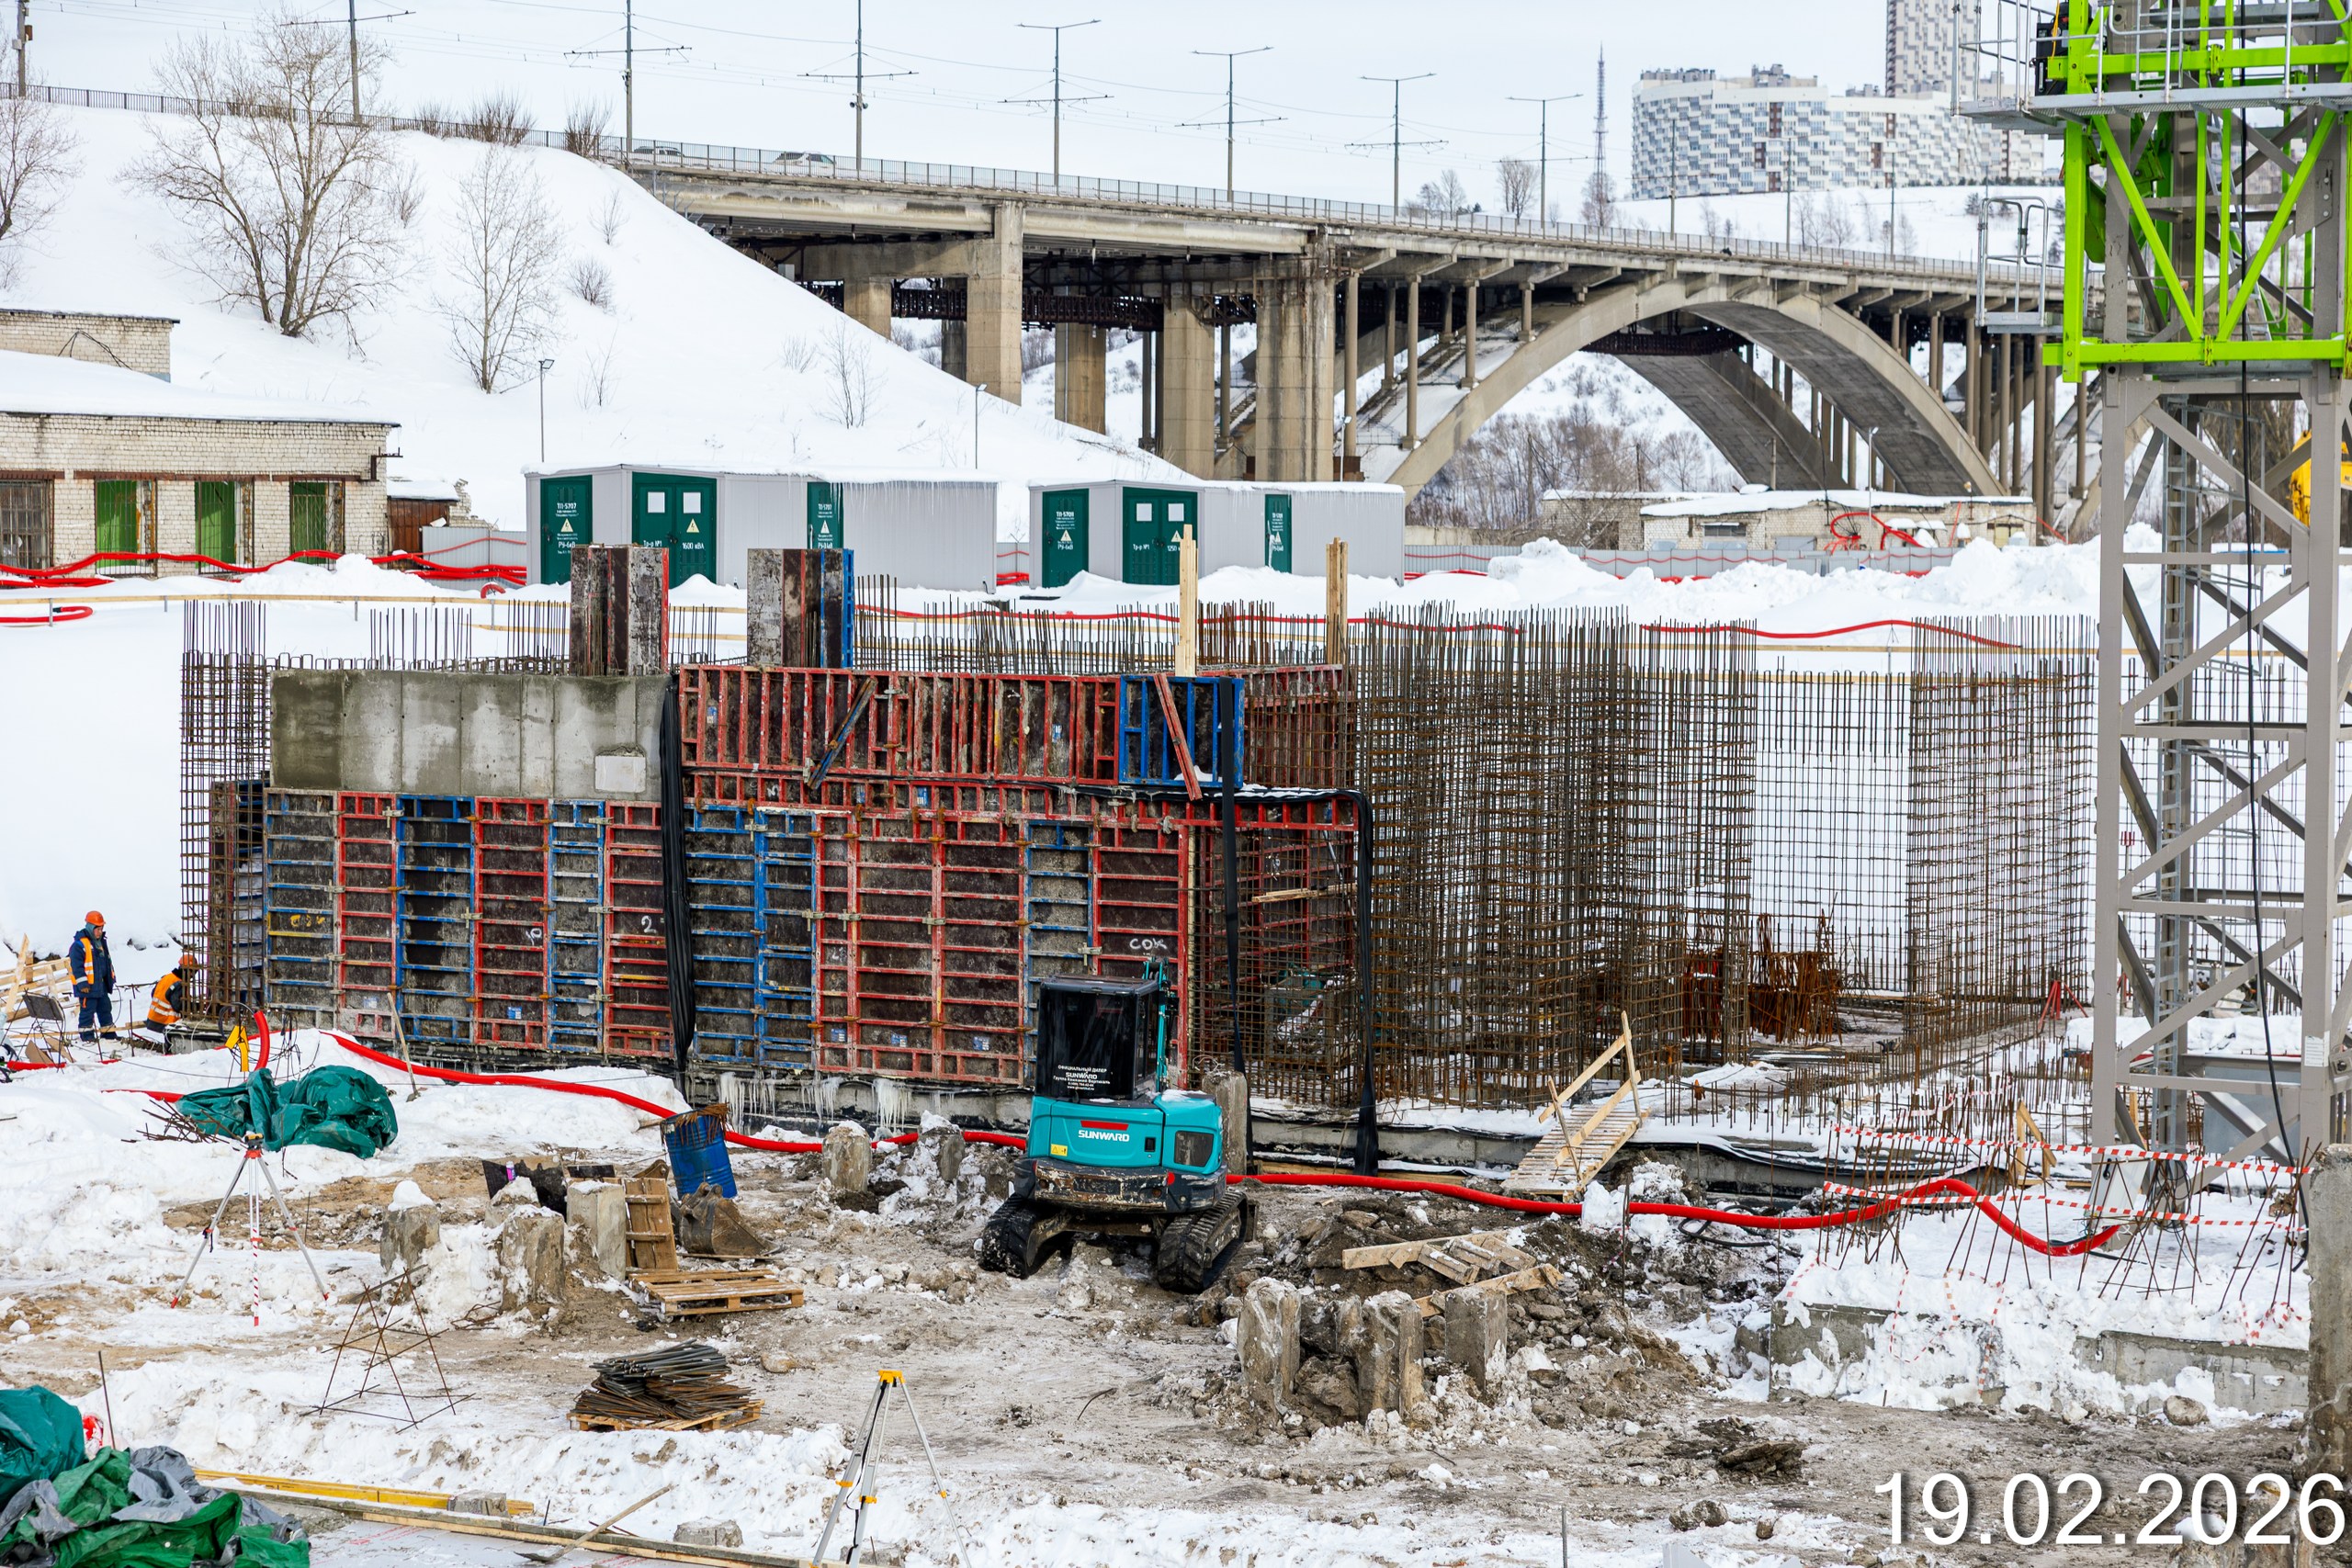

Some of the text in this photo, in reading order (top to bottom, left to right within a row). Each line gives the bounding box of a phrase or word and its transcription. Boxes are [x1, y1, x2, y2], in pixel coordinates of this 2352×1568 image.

[682, 542, 694, 550] 1600
[640, 915, 658, 934] 2
[1057, 1065, 1091, 1073] ОФИЦИАЛЬНЫЙ
[1066, 1072, 1098, 1080] SUNWARD
[1078, 1129, 1130, 1143] SUNWARD
